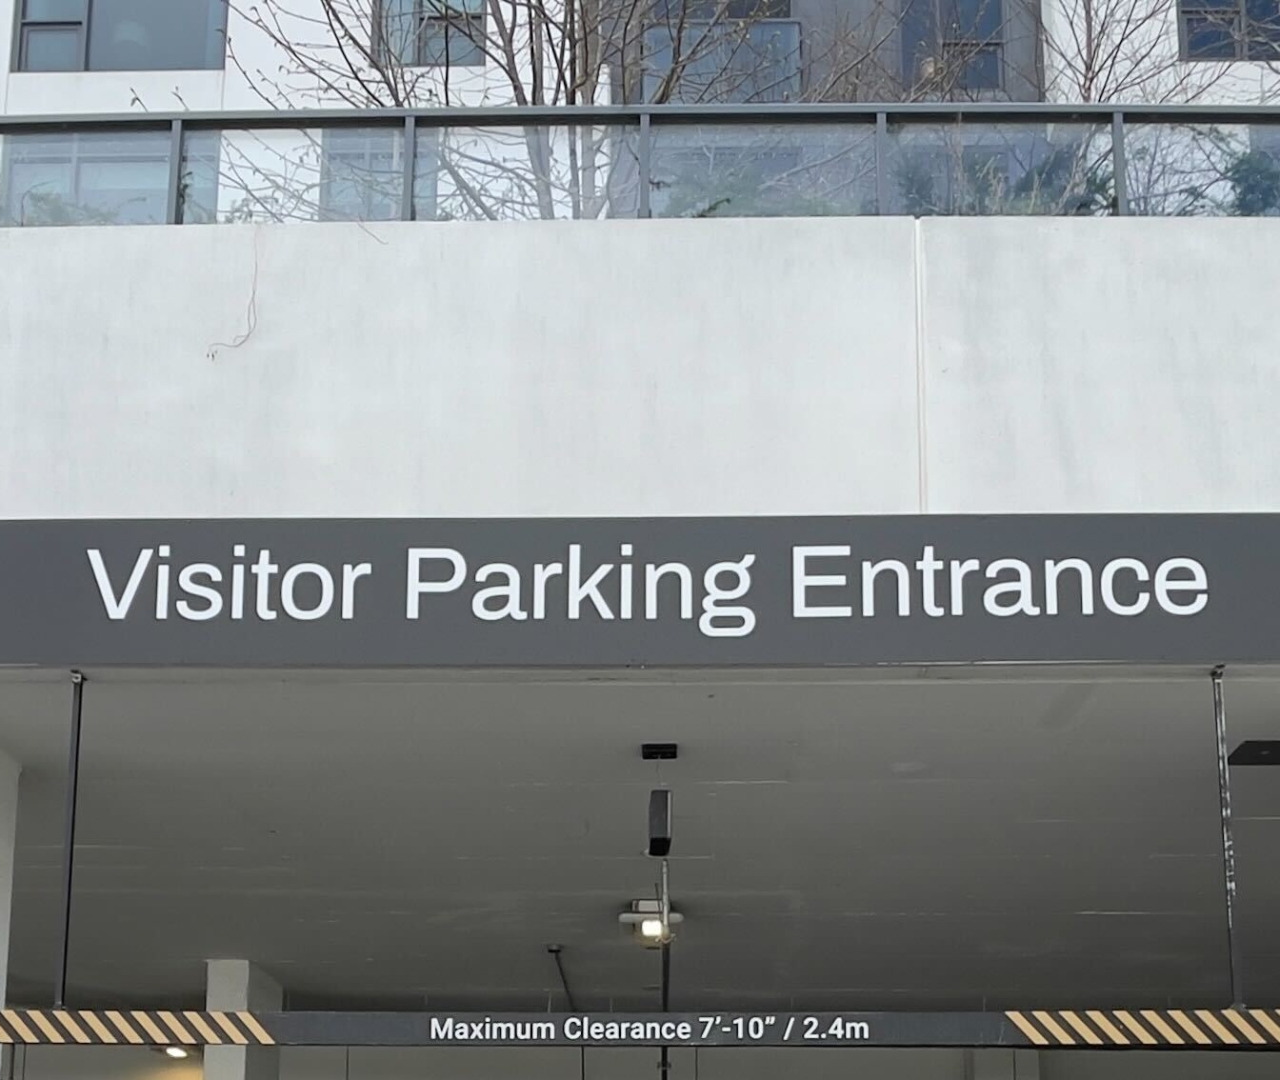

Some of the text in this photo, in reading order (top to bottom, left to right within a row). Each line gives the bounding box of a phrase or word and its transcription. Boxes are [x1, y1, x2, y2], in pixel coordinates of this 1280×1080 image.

[86, 543, 1208, 637] Visitor Parking Entrance
[430, 1016, 556, 1040] Maximum
[563, 1016, 692, 1040] Clearance
[783, 1016, 796, 1041] /
[803, 1016, 870, 1039] 2.4m
